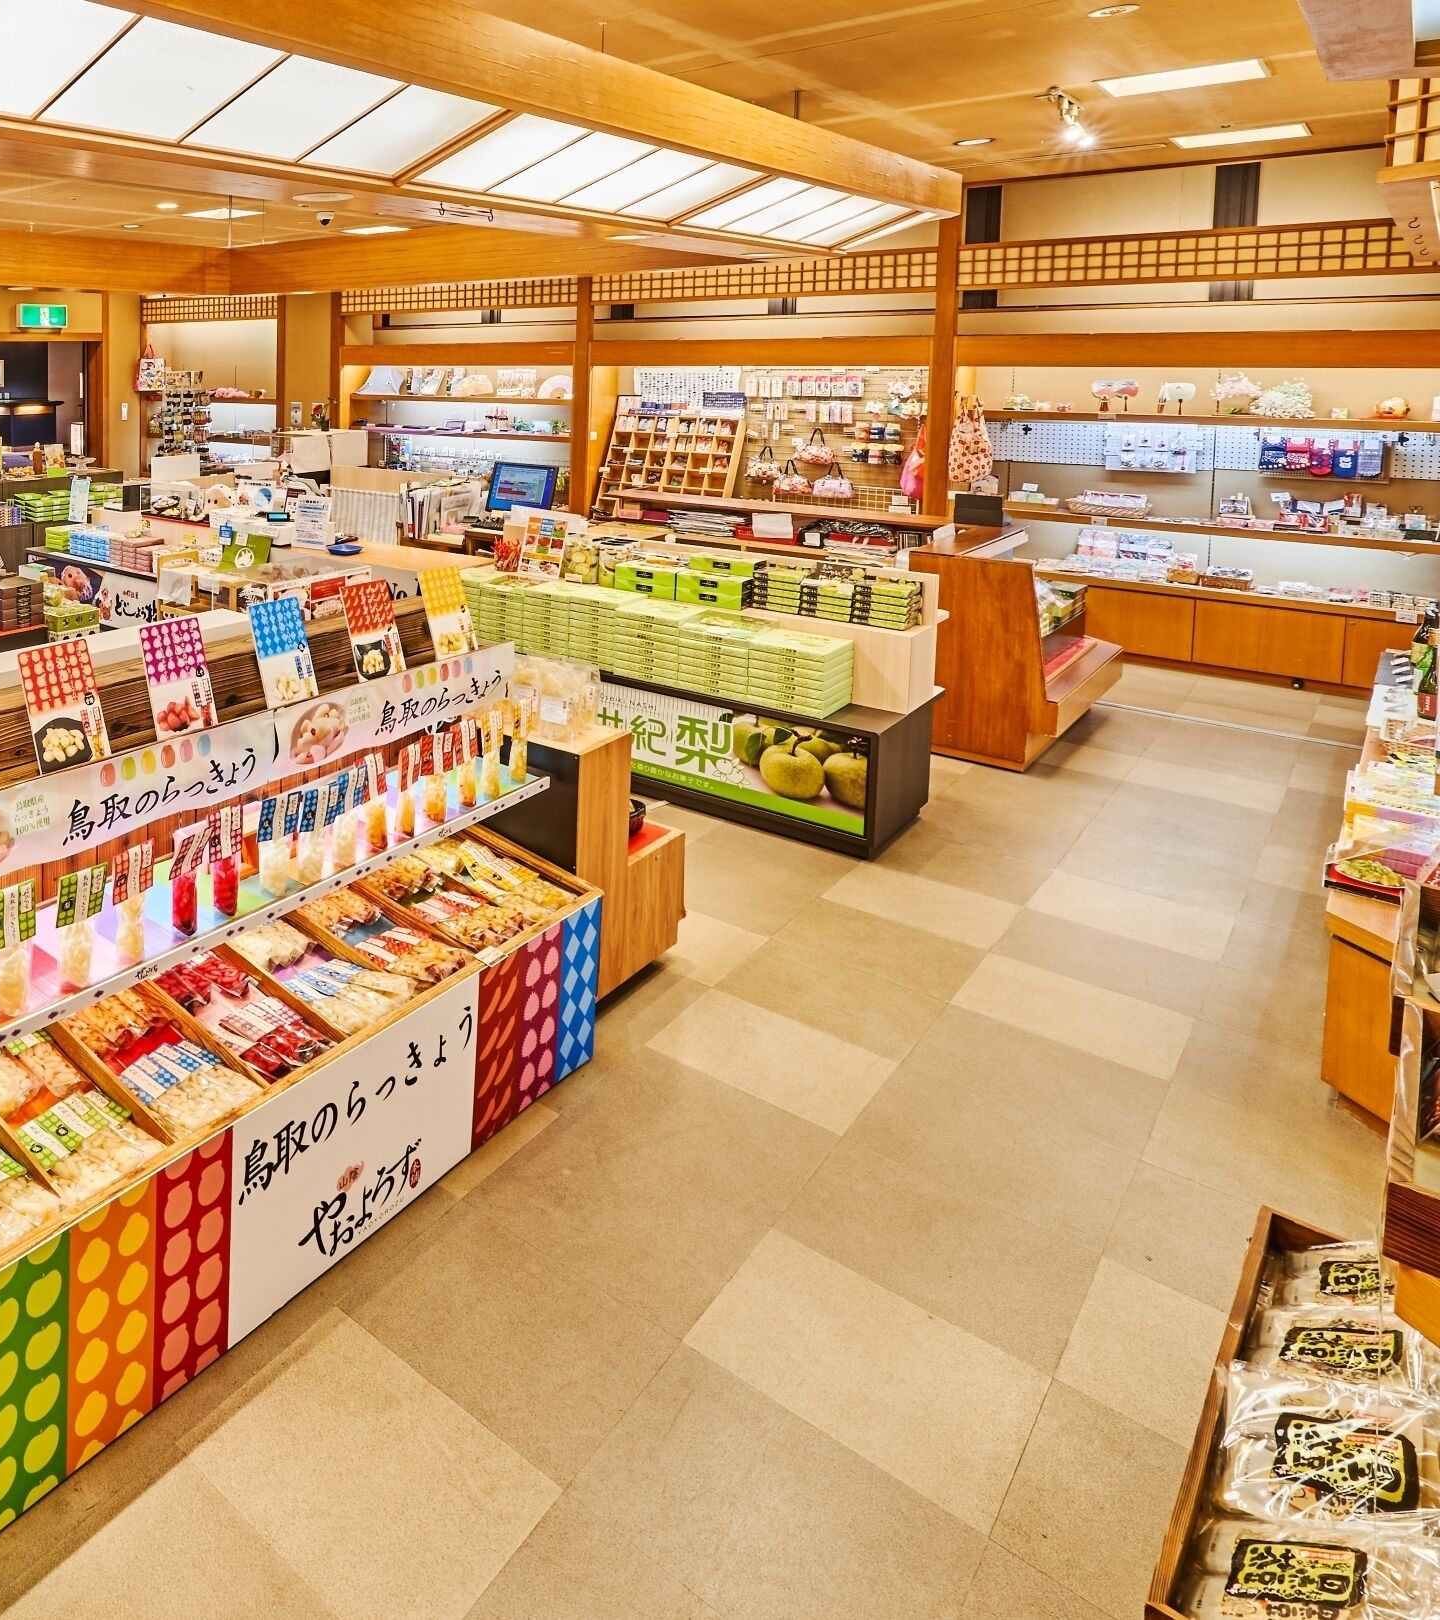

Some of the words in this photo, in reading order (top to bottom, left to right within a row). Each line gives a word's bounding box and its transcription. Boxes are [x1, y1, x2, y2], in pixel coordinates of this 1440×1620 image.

[374, 668, 502, 736] 鳥取のらっきょう
[629, 699, 657, 711] NASHI
[13, 805, 49, 823] らっきょう
[62, 746, 257, 846] 鳥取のらっきょう
[15, 816, 51, 836] 100%使用
[238, 1004, 473, 1206] 鳥取のらっきょう
[297, 1137, 422, 1257] やおよろず
[339, 1167, 359, 1189] 山陰
[358, 1195, 405, 1235] YAOYOROZU
